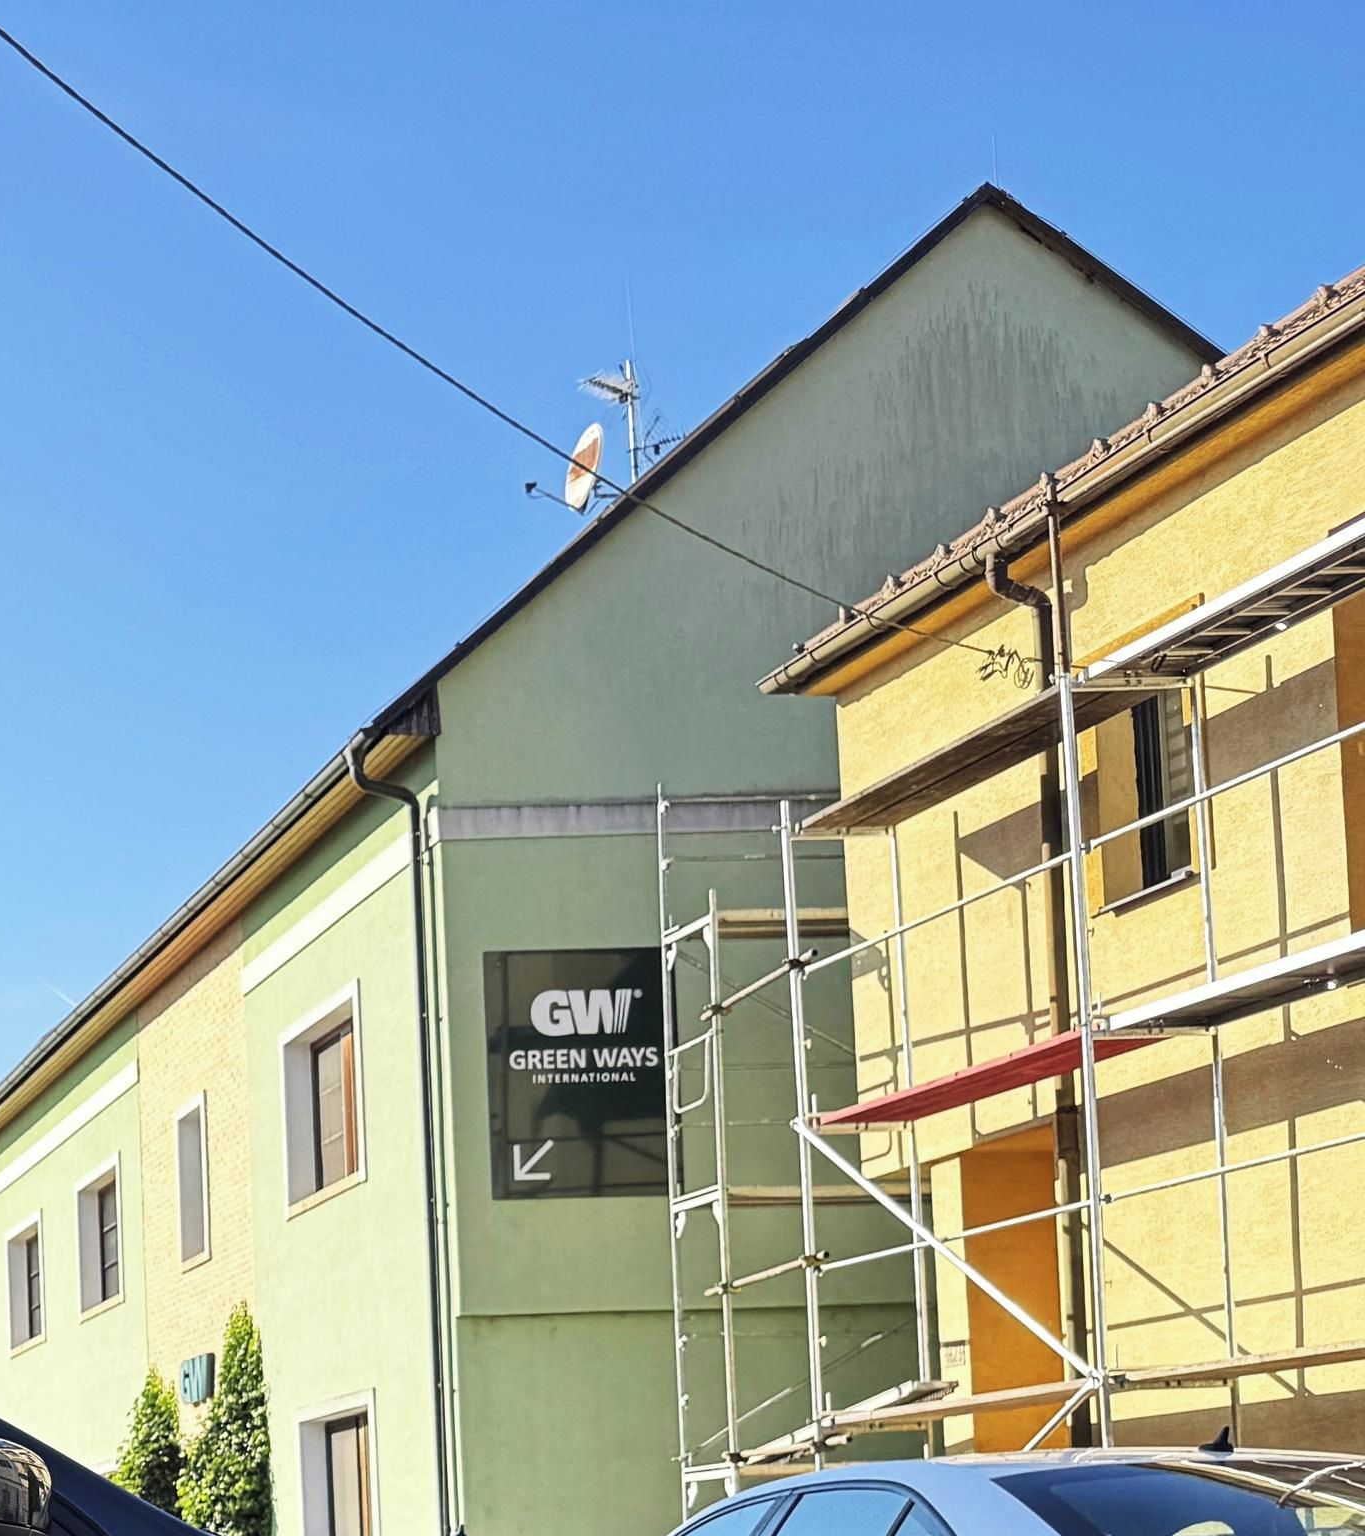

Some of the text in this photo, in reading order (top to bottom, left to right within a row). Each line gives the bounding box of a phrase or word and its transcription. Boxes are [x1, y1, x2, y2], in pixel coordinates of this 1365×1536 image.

[530, 988, 633, 1037] GW
[508, 1047, 659, 1071] GREEN WAYS
[531, 1072, 637, 1084] INTERNATIONAL
[180, 1353, 214, 1404] GW
